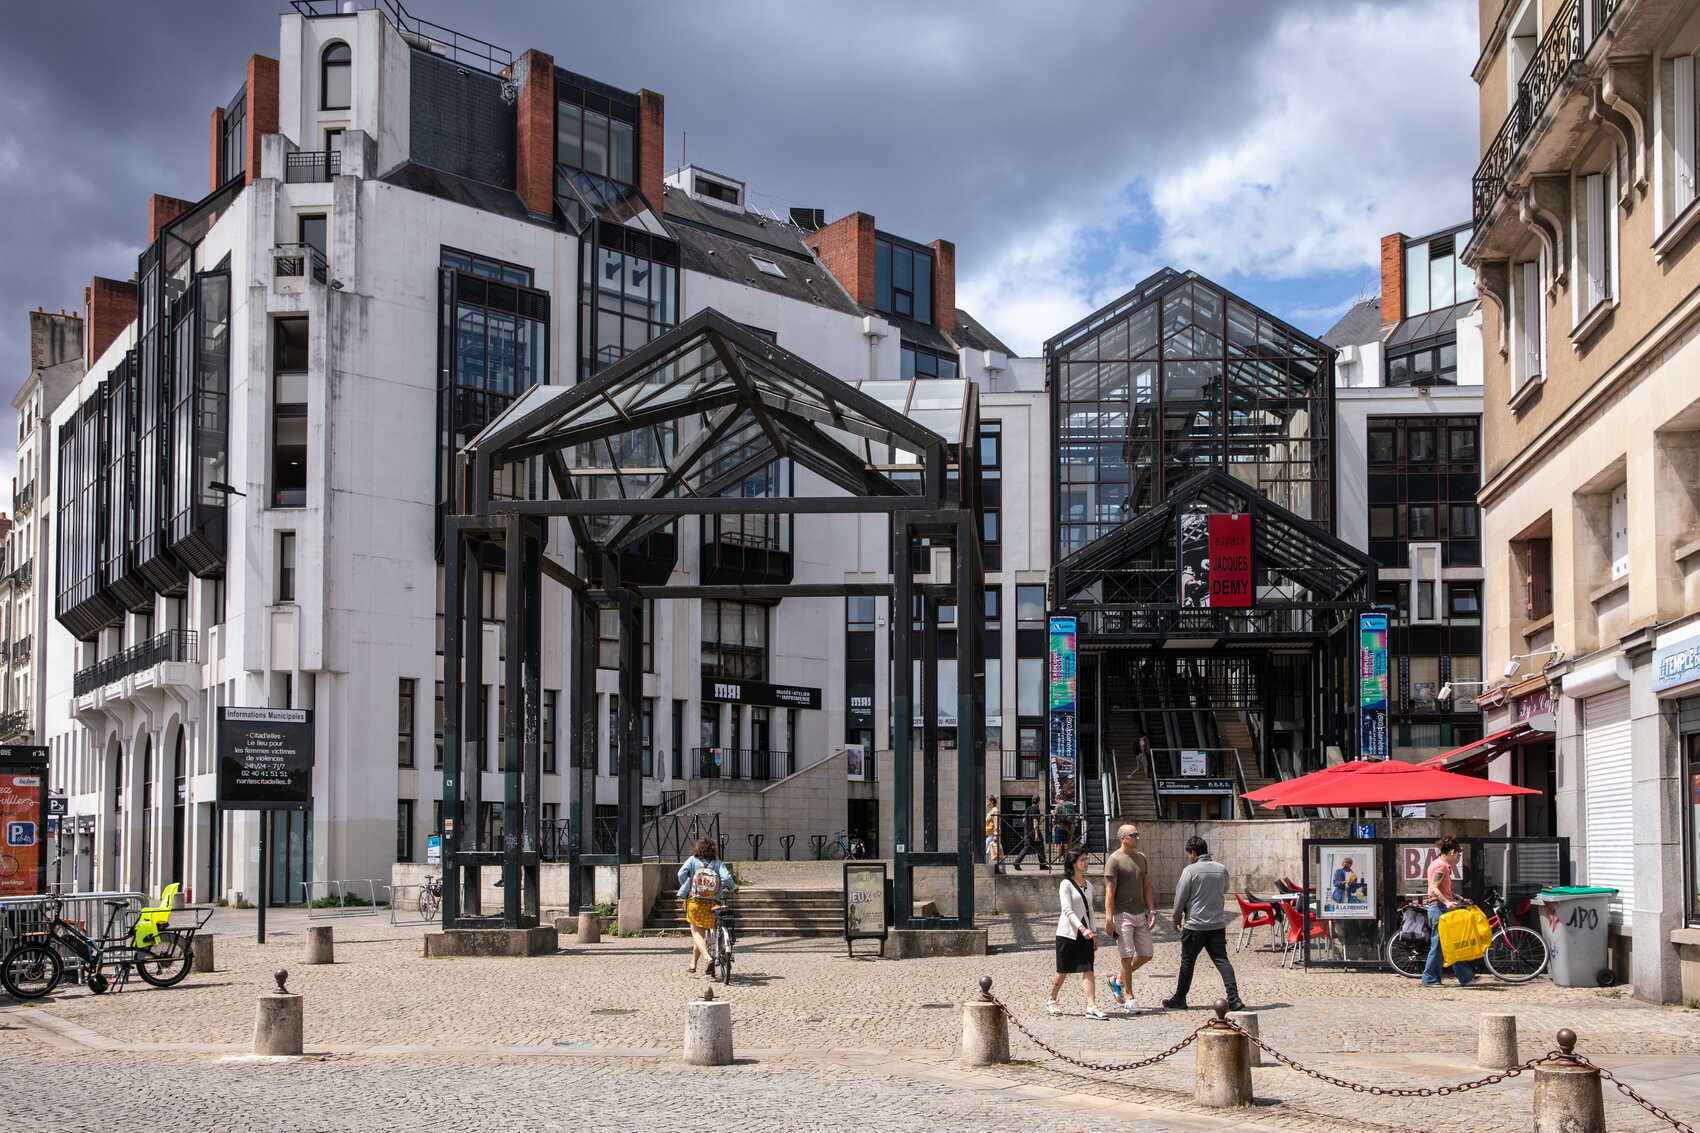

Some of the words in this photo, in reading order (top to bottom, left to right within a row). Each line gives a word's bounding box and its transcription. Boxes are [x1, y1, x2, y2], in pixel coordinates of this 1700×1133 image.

[1214, 555, 1248, 572] JACQUES
[1213, 579, 1249, 595] DEMY
[227, 710, 267, 719] Informations
[268, 711, 304, 720] Municipales
[51, 800, 58, 812] P
